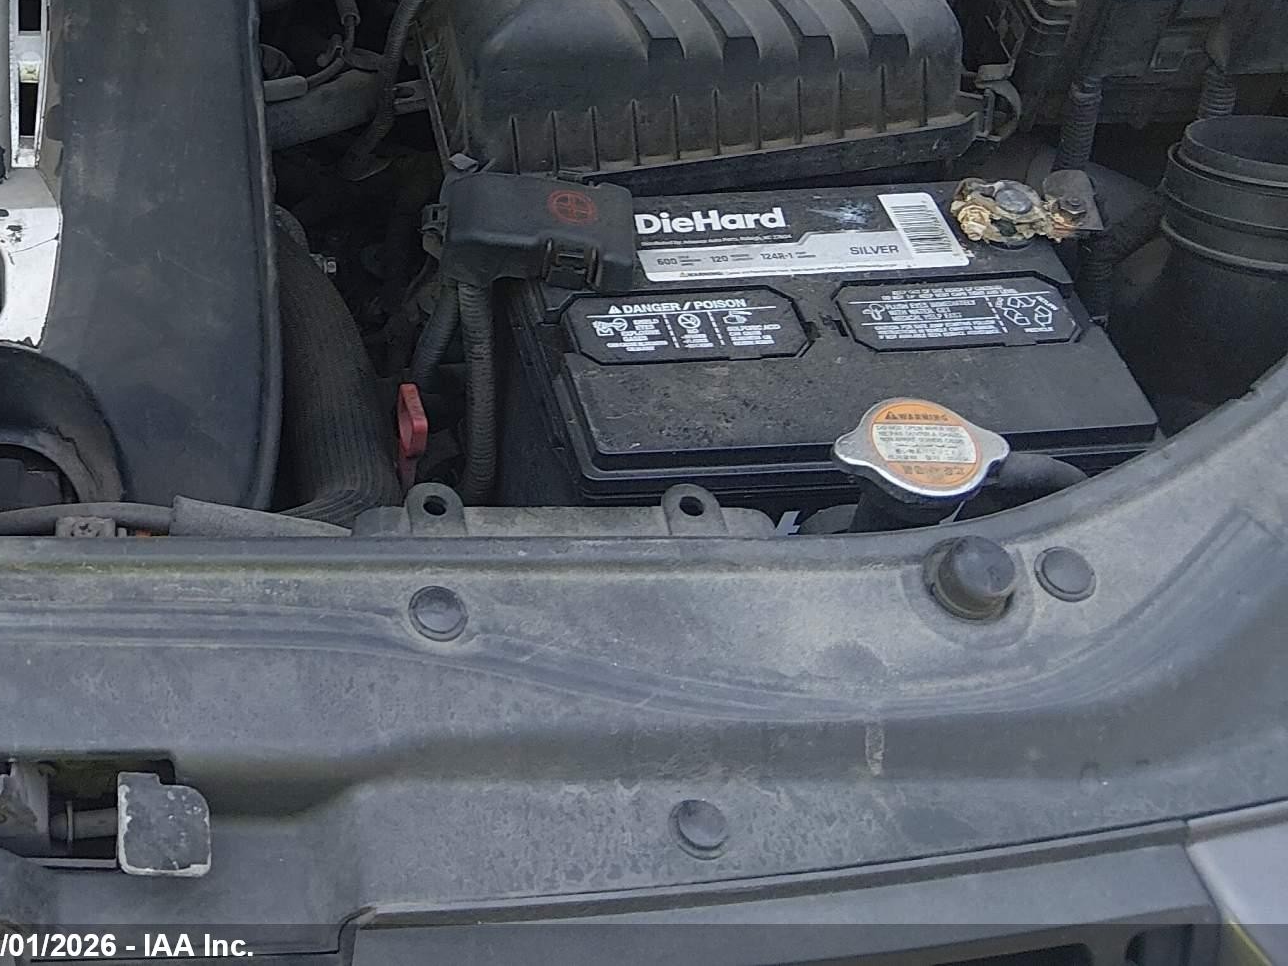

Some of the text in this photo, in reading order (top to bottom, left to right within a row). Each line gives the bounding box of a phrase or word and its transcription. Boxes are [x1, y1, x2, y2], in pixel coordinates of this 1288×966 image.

[634, 207, 786, 234] DieHard
[849, 245, 900, 256] SILVER
[711, 255, 729, 263] 120
[622, 302, 681, 314] DANGER
[693, 299, 748, 310] POISON
